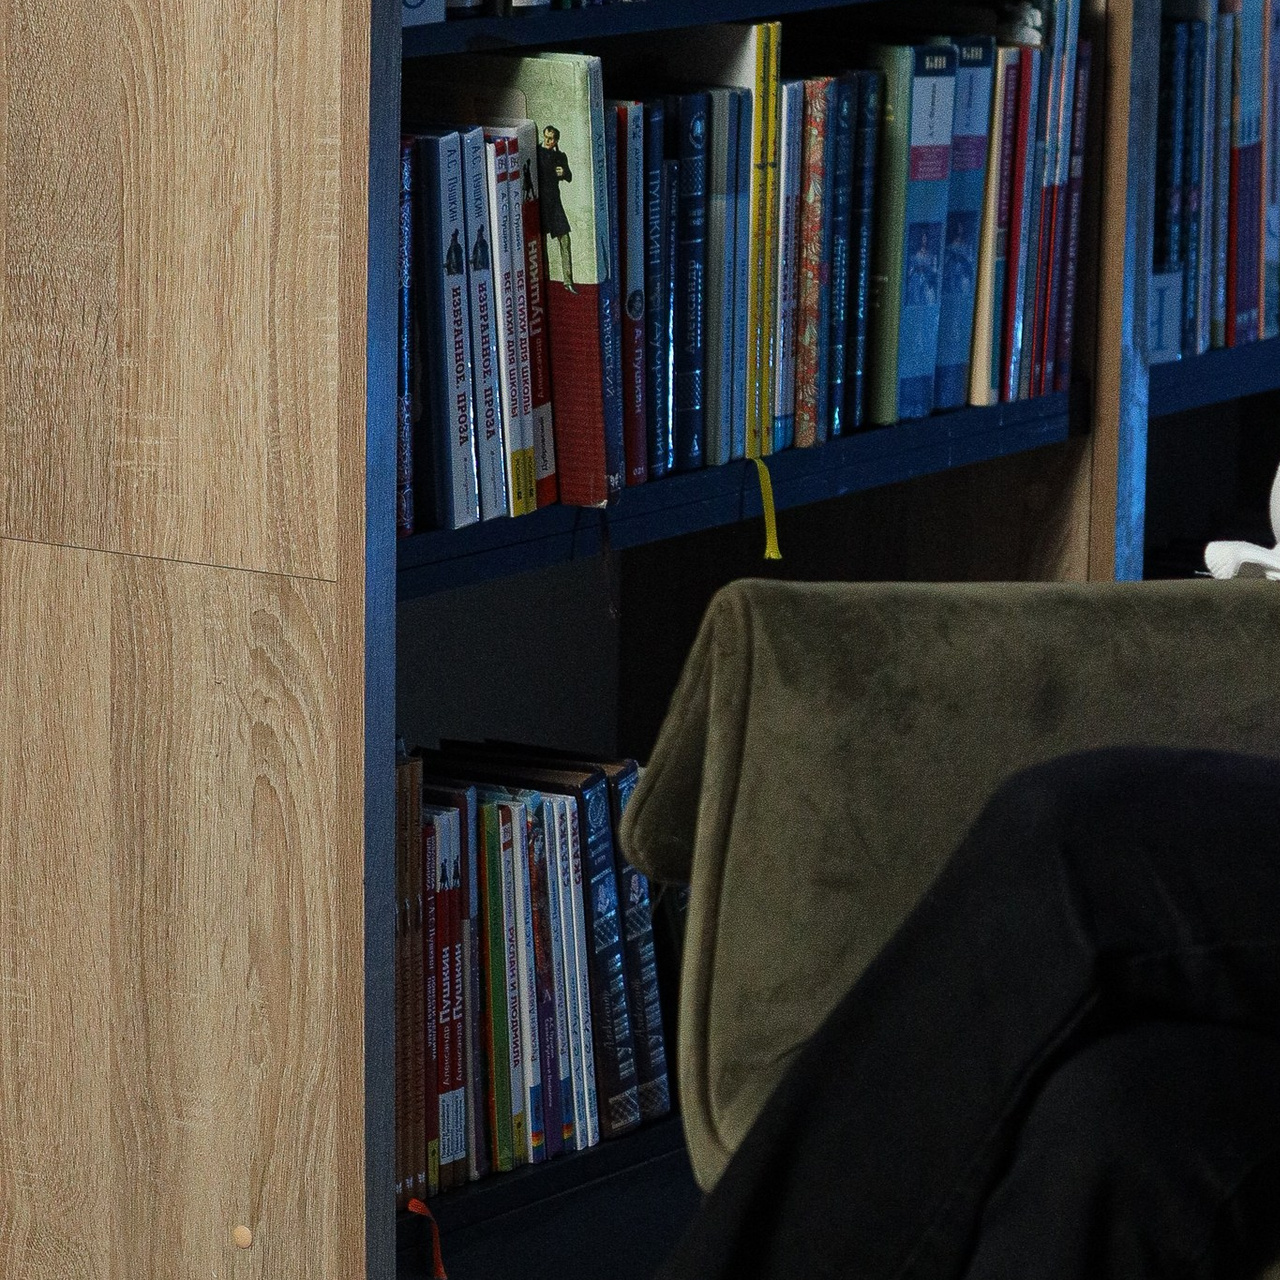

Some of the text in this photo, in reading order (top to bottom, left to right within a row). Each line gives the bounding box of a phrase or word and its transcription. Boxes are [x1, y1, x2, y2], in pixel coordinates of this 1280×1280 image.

[446, 149, 458, 172] А.С.
[471, 145, 482, 169] А.С.
[501, 215, 510, 253] Пушкин
[513, 213, 522, 251] Пушкин
[648, 169, 661, 265] ПУШКИН
[452, 286, 465, 389] ИЗБРАННОЕ.
[478, 283, 491, 384] ИЗБРАННОЕ.
[504, 271, 518, 418] ВСЕ СТИХИ ДЛЯ ШКОЛЫ
[516, 269, 531, 416] ВСЕ СТИХИ ДЛЯ ШКОЛЫ
[528, 240, 545, 399] Александр Пушкин
[603, 298, 615, 398] ДУБРОВСКИЙ
[457, 393, 468, 447] ПРОЗА
[484, 387, 496, 441] ПРОЗА
[632, 348, 643, 414] Пушкин
[558, 813, 570, 888] СКАЗКИ
[571, 810, 581, 886] СКАЗКИ
[507, 927, 517, 978] РУСЛАН
[439, 946, 451, 1085] Александр Пушкин
[452, 943, 464, 1082] Александр Пушкин
[510, 995, 521, 1069] ЛЮДМИЛА
[608, 953, 635, 1081] ПУШКИН
[638, 941, 665, 1068] ПУШКИН
